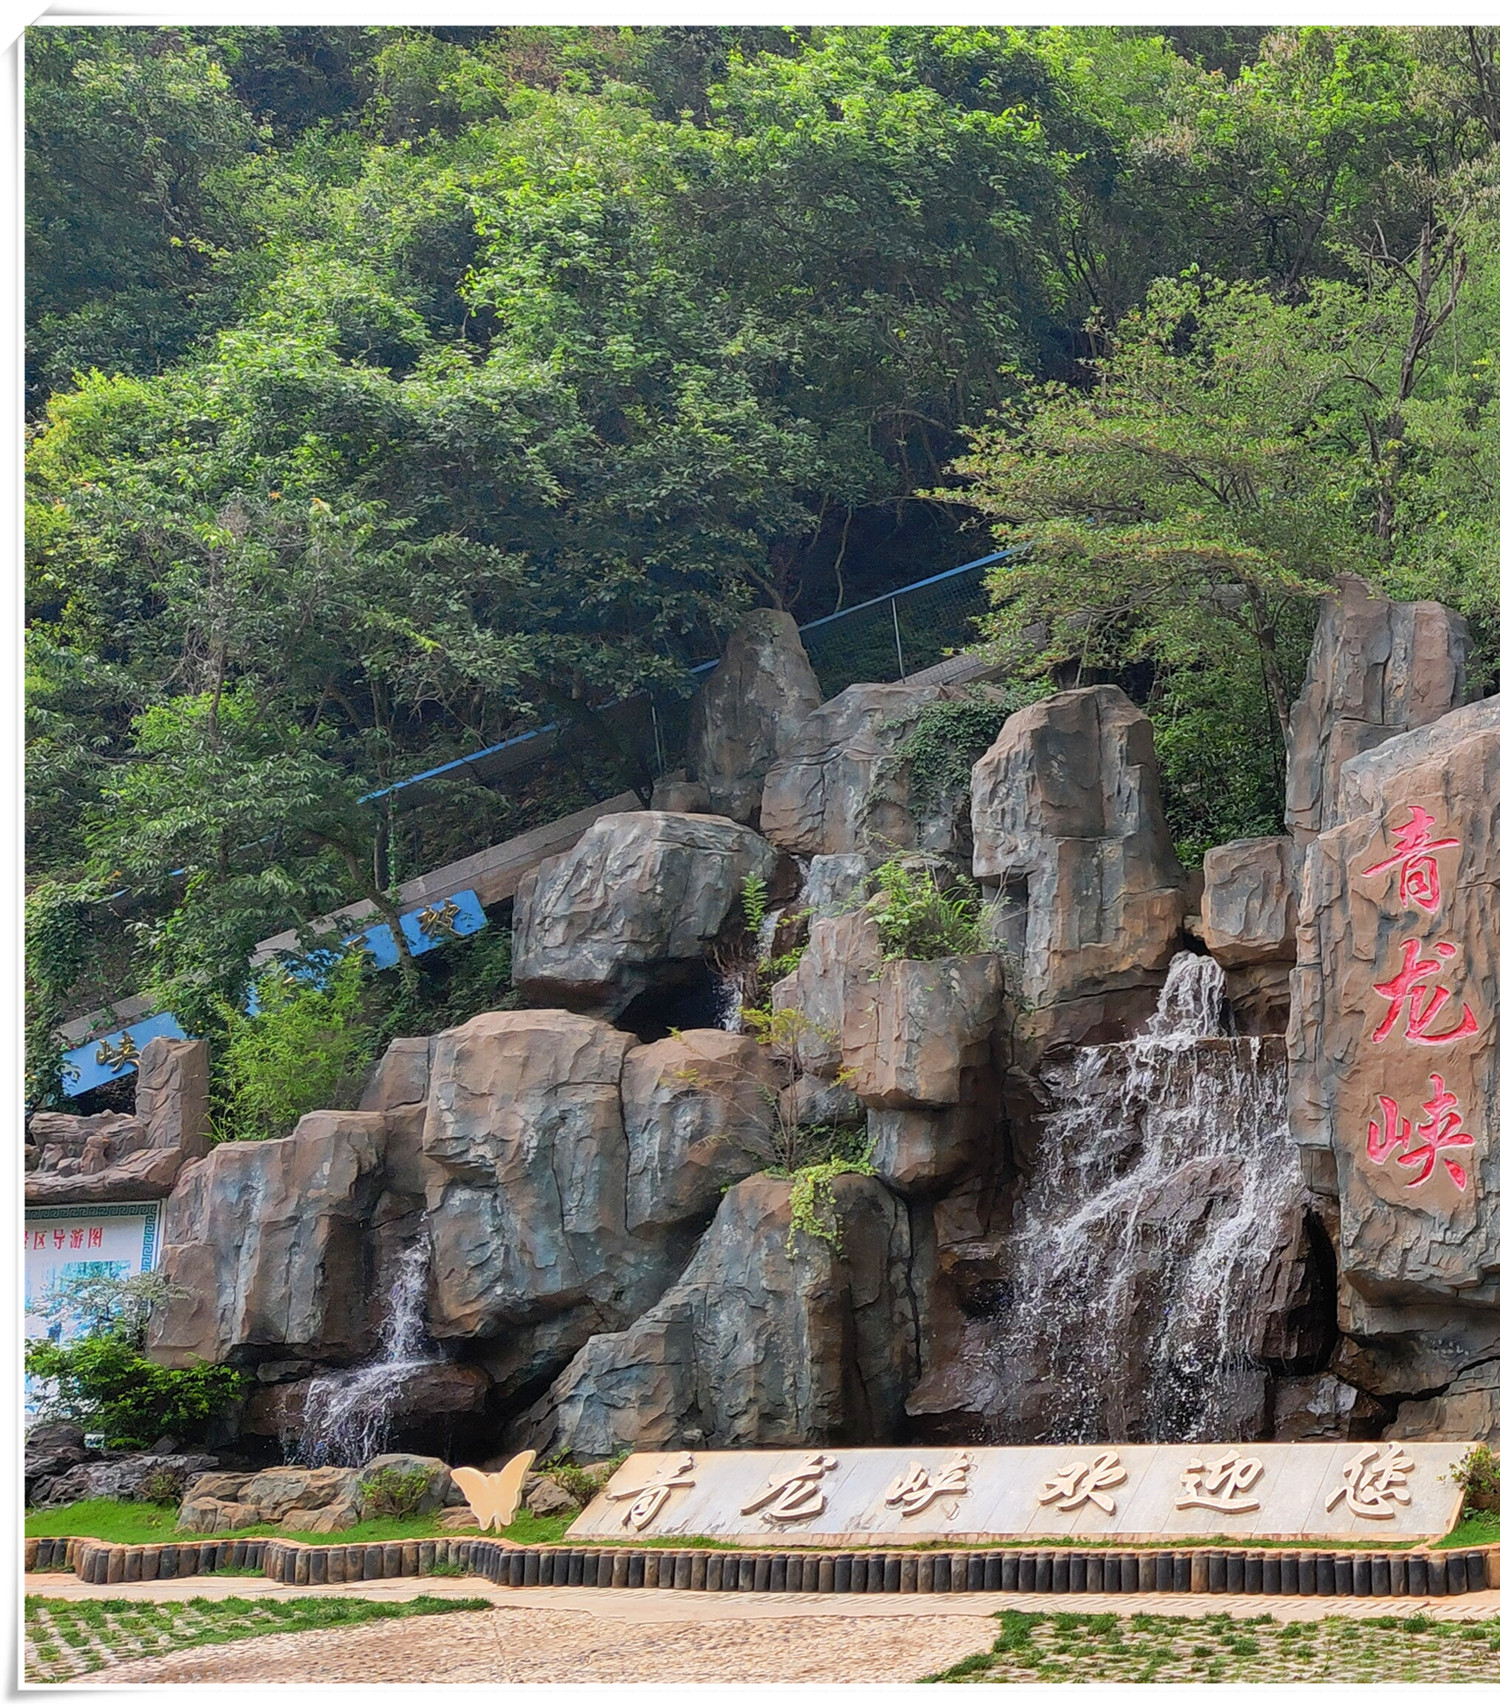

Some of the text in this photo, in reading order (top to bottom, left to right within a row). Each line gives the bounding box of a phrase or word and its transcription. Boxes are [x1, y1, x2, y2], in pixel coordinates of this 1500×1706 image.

[1362, 804, 1479, 1194] 青龙峡
[605, 1441, 1416, 1532] 青龙峡欢迎您
